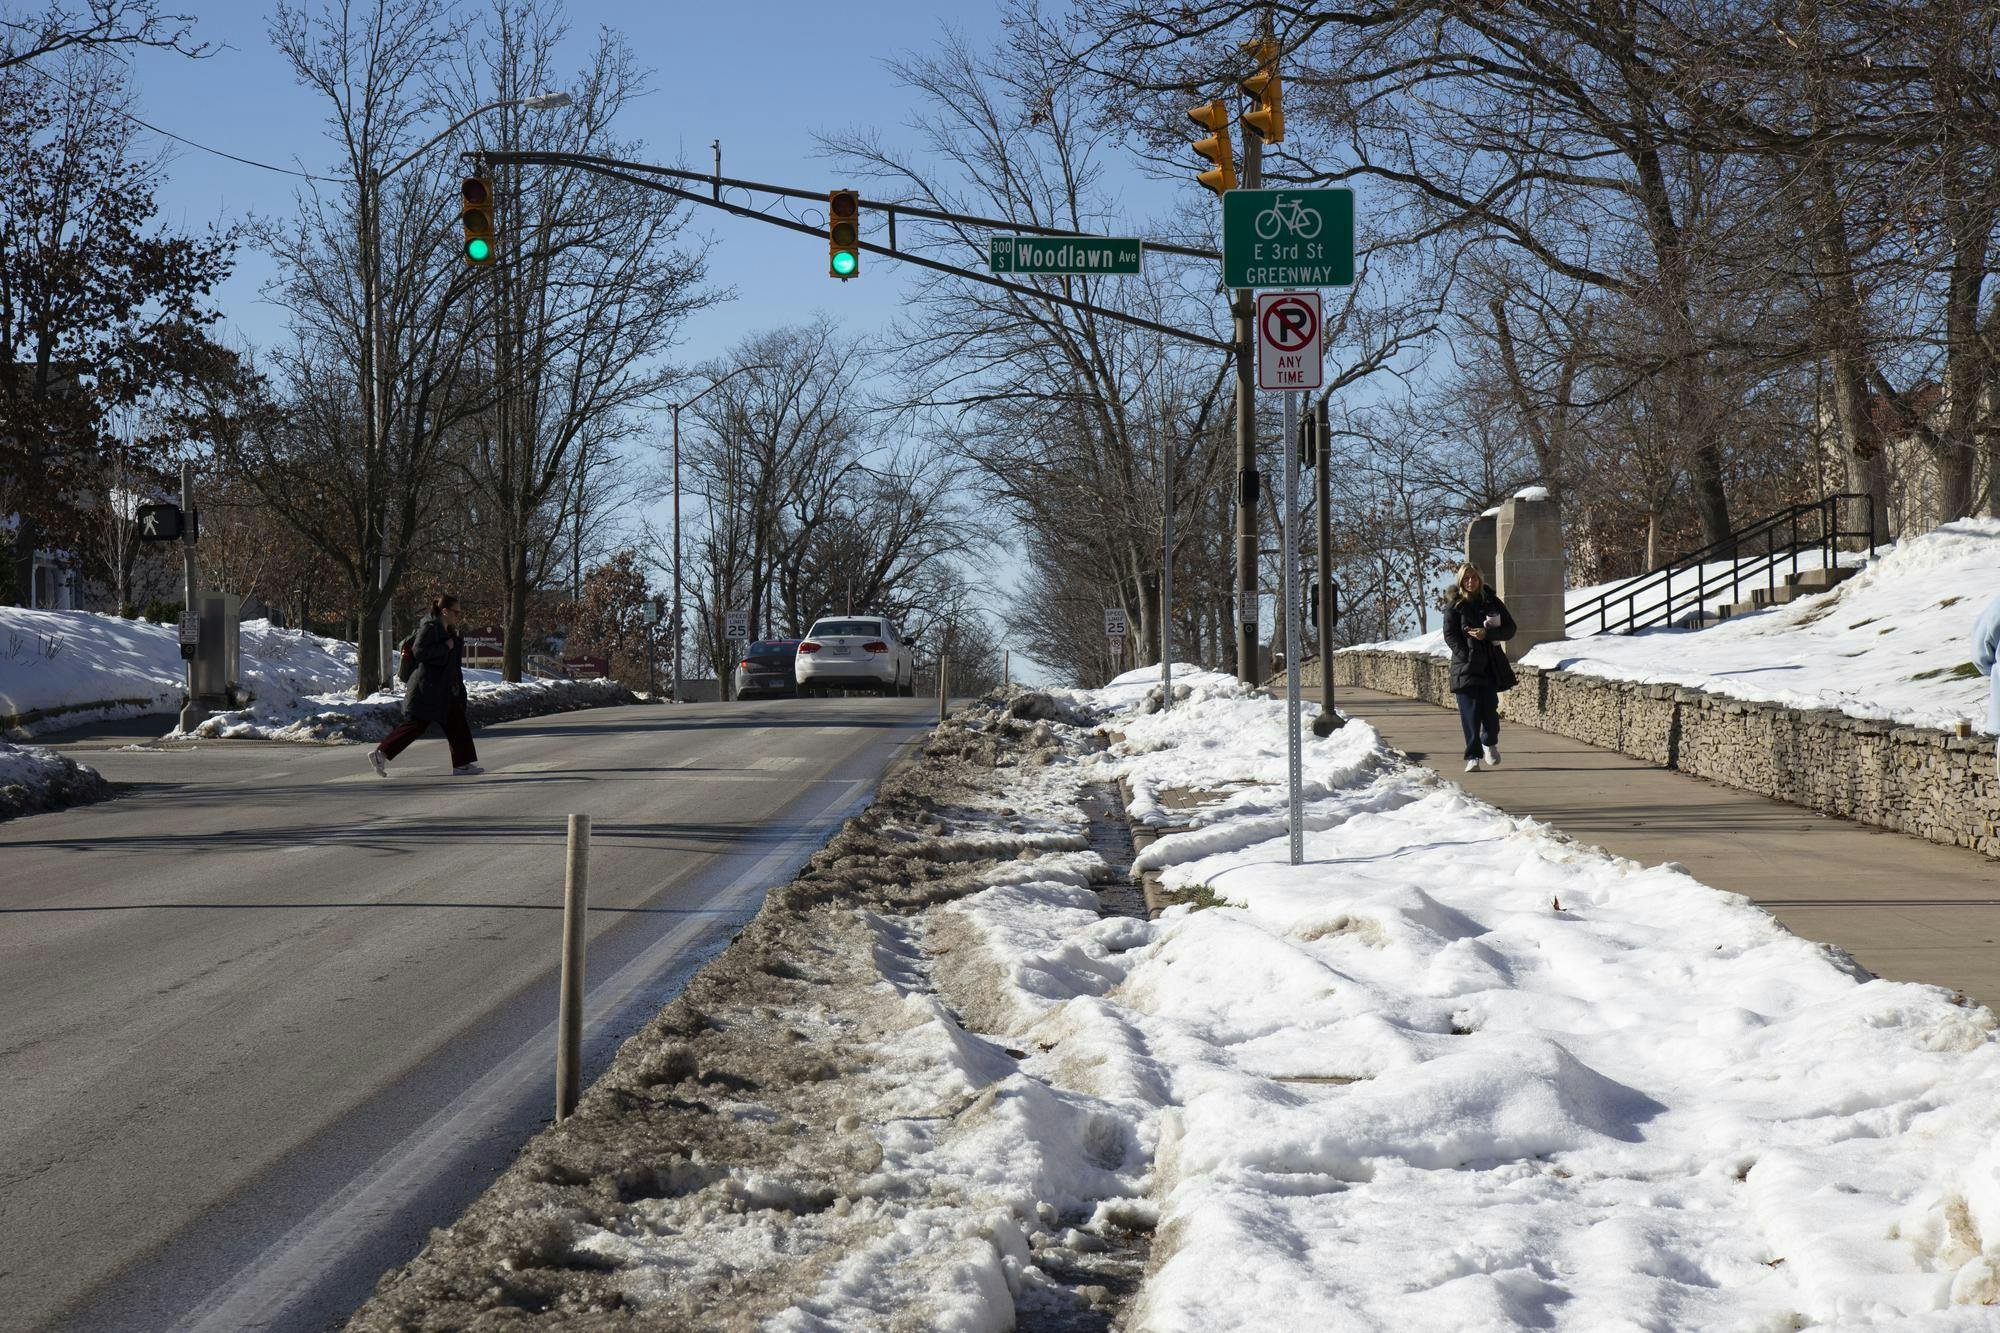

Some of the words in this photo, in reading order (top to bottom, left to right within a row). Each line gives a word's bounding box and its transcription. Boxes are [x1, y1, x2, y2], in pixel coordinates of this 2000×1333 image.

[993, 241, 1011, 254] 300
[1254, 244, 1263, 260] E
[1272, 243, 1298, 260] 3rd
[1306, 242, 1323, 260] St
[999, 256, 1005, 269] S
[1018, 244, 1113, 268] Woodlawn
[1118, 250, 1136, 263] Ave
[1246, 265, 1332, 284] GREENWAY
[1278, 356, 1302, 369] ANY
[1277, 371, 1304, 384] TIME
[728, 625, 746, 636] 25
[1107, 622, 1124, 633] 25
